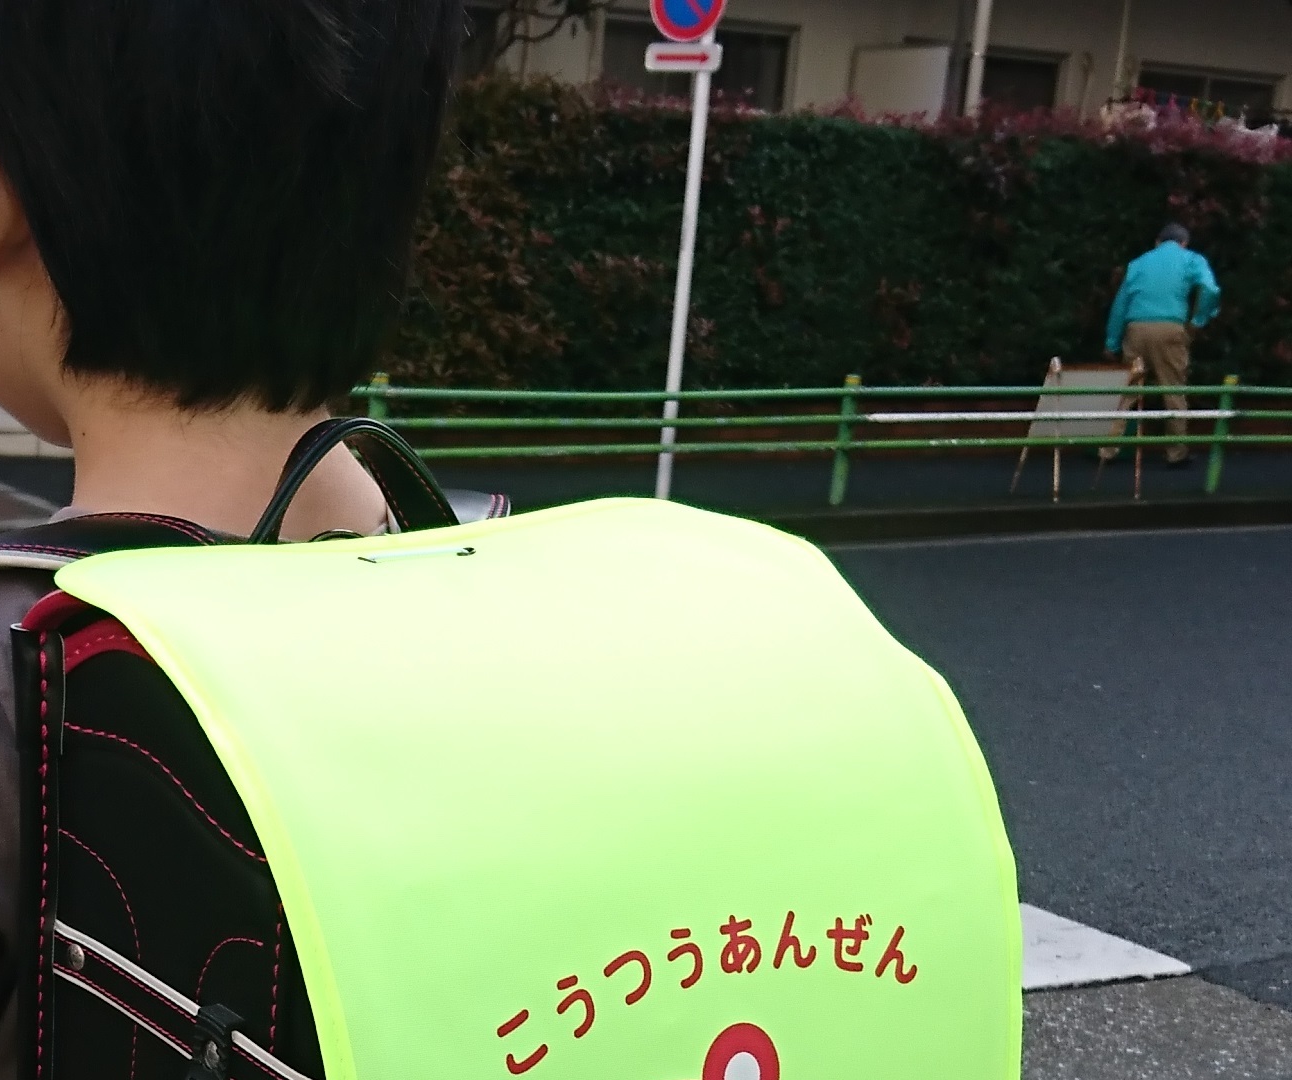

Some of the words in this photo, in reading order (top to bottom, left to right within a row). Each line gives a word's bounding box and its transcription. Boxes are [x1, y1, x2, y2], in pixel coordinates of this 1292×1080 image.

[497, 911, 918, 1075] こうつうあんぜん
